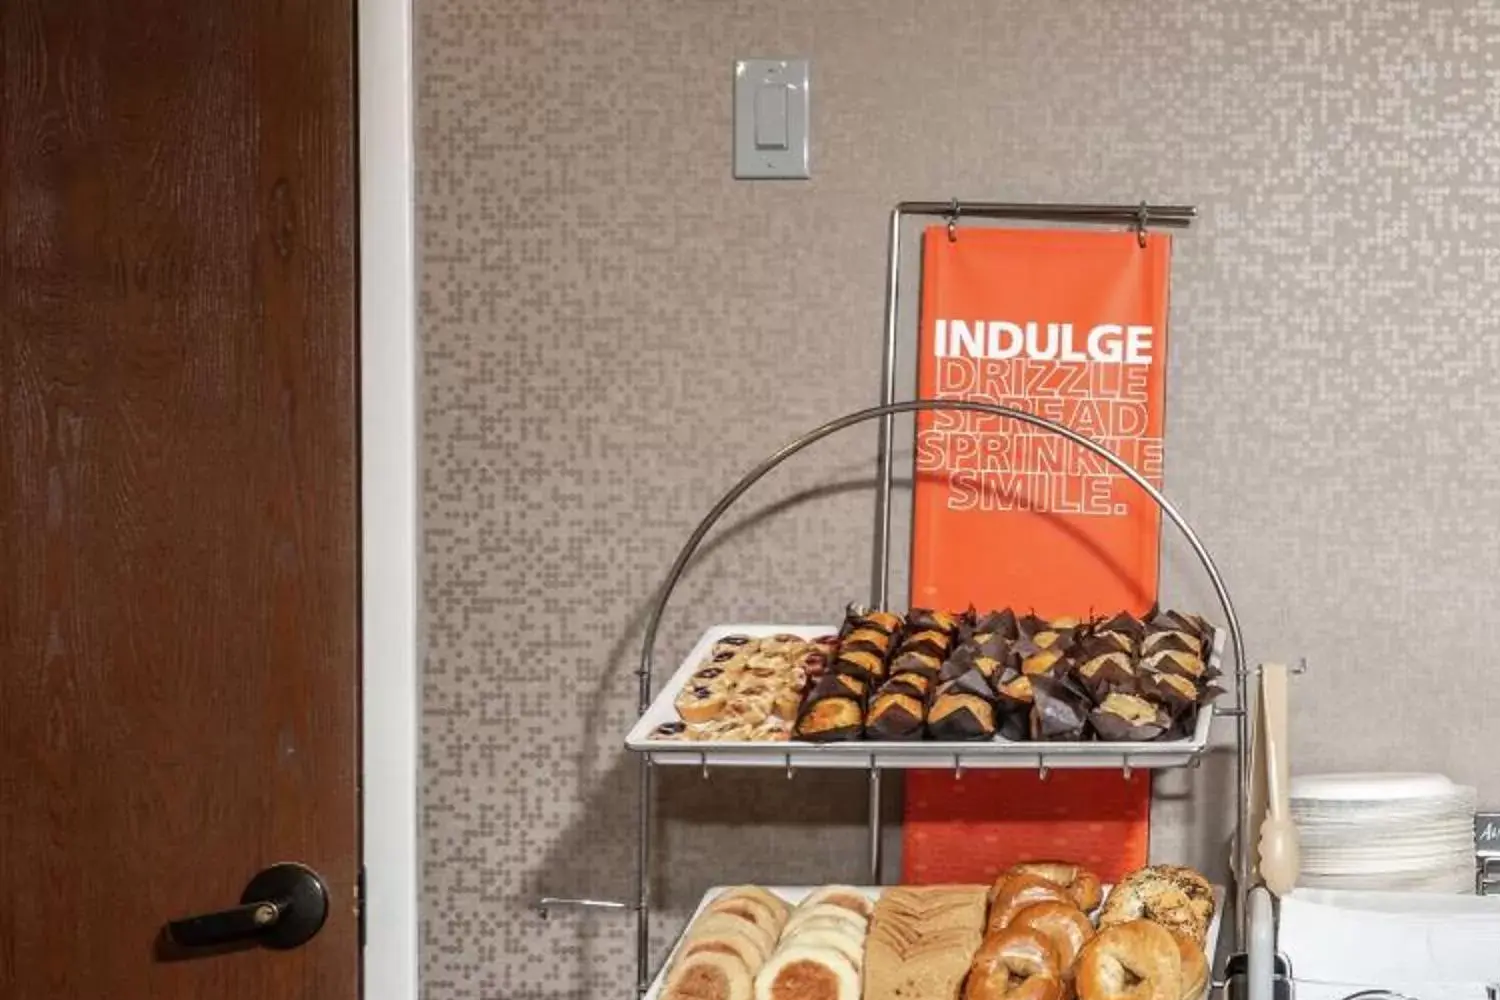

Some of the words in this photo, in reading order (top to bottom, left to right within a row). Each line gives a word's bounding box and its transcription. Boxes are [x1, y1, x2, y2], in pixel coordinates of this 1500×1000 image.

[933, 319, 1153, 364] INDULGE
[935, 357, 1149, 402] DRIZZLE
[931, 393, 1148, 438] SPREAD
[948, 470, 1128, 515] SMILE.
